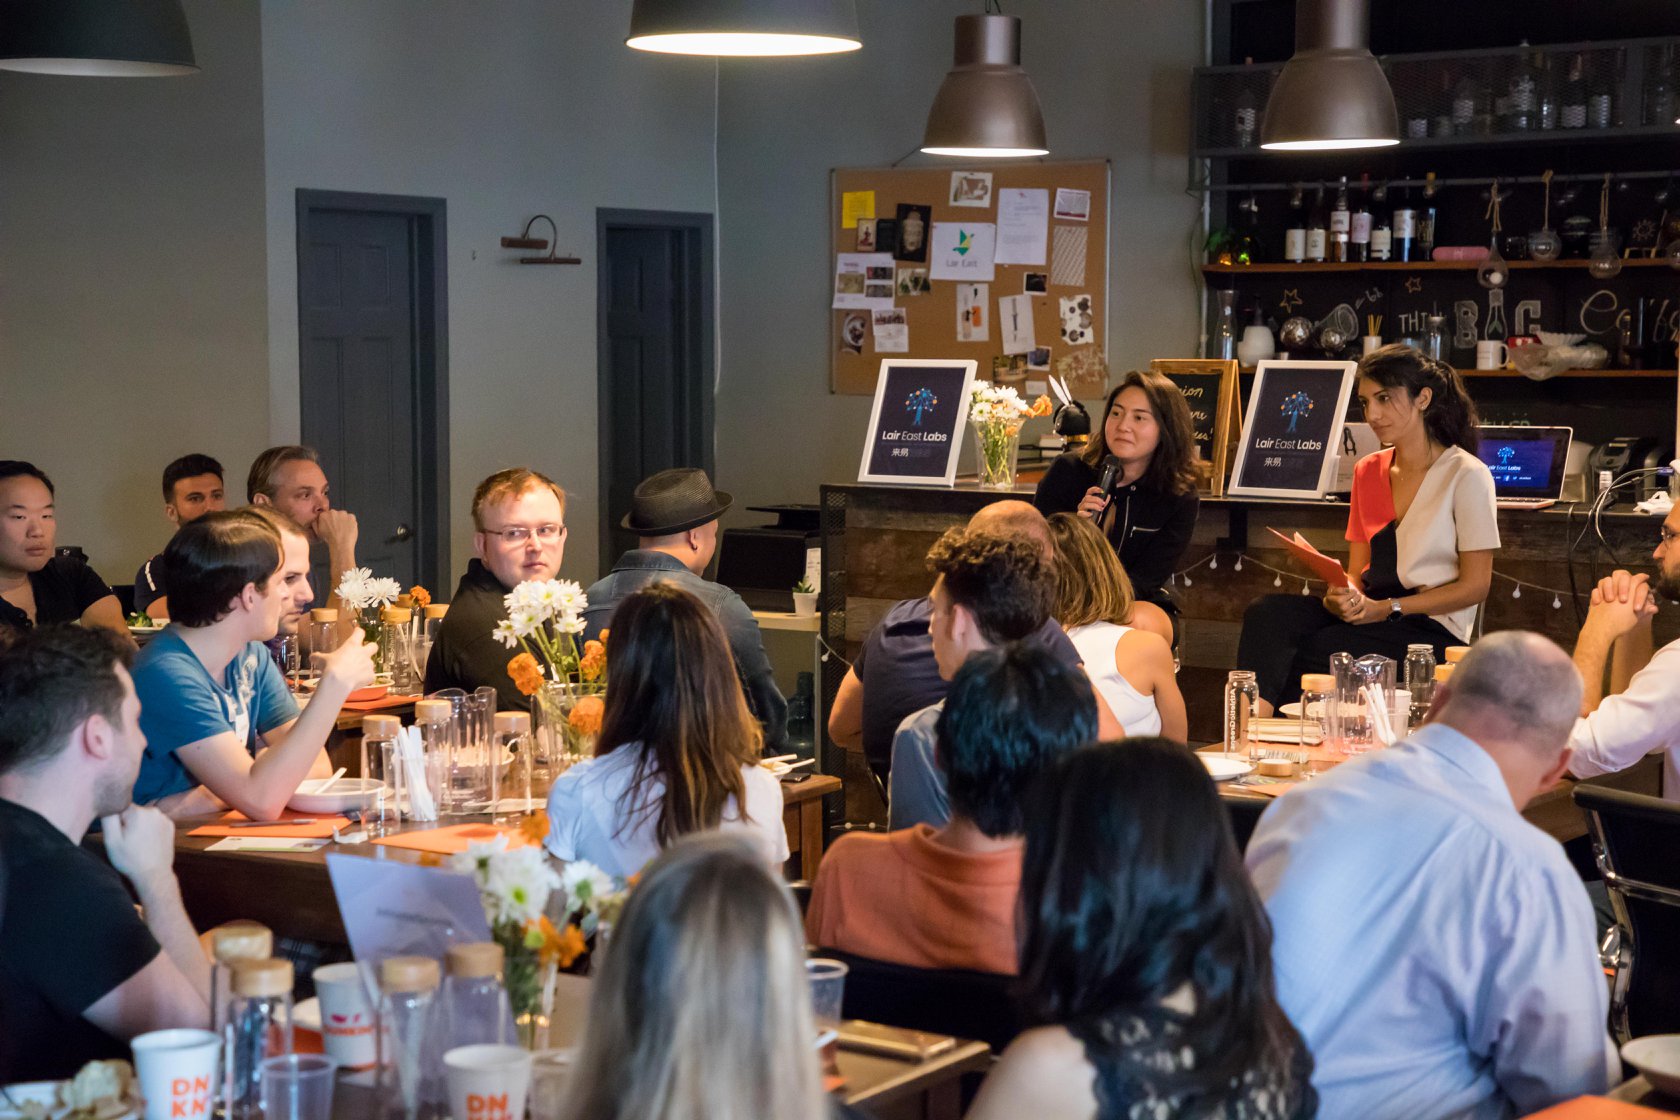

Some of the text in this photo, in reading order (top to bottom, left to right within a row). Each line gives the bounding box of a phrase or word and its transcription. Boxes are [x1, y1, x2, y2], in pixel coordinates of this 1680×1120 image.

[882, 430, 947, 442] Lair East Labs
[1255, 437, 1322, 450] Lair East Labs
